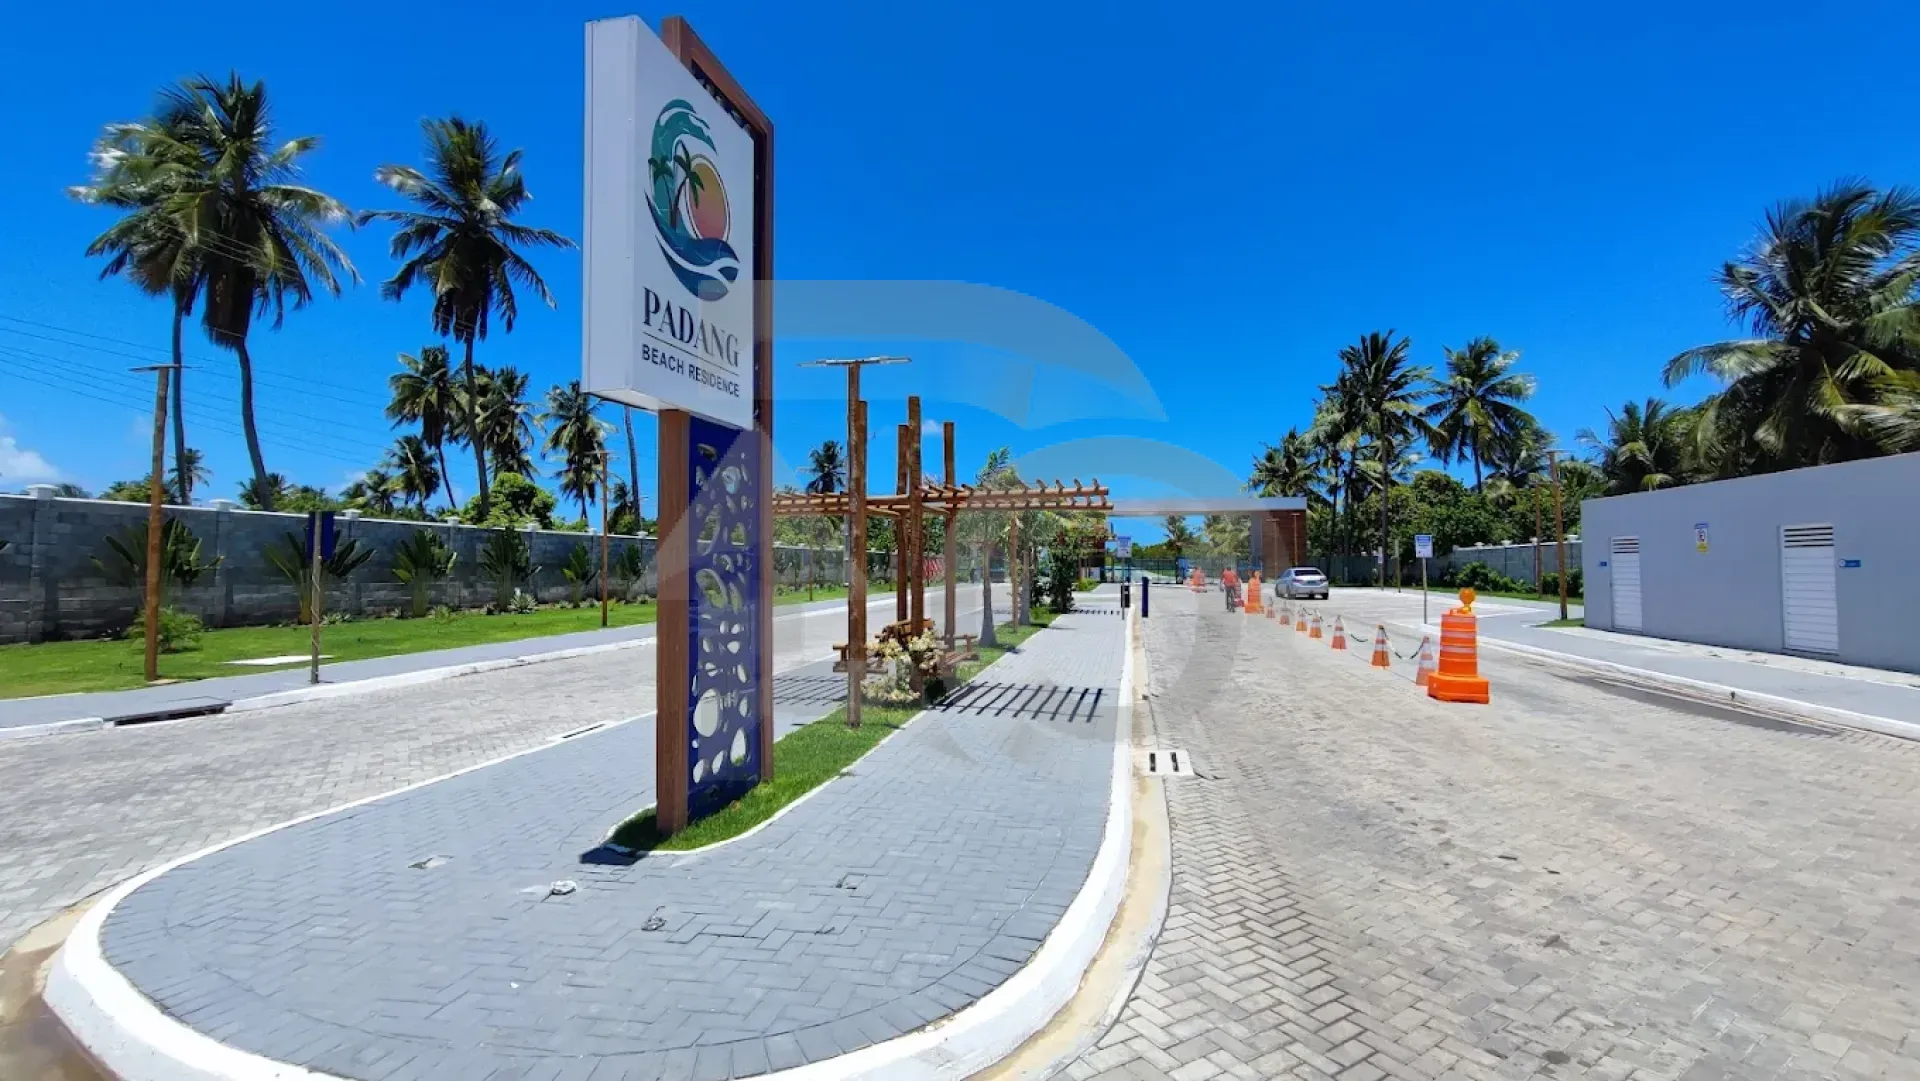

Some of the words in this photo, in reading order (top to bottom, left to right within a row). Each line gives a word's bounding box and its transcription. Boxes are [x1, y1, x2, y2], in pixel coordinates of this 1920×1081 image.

[643, 286, 740, 367] PADANG
[642, 344, 684, 374] BEACH
[688, 364, 739, 397] RESIDENCE
